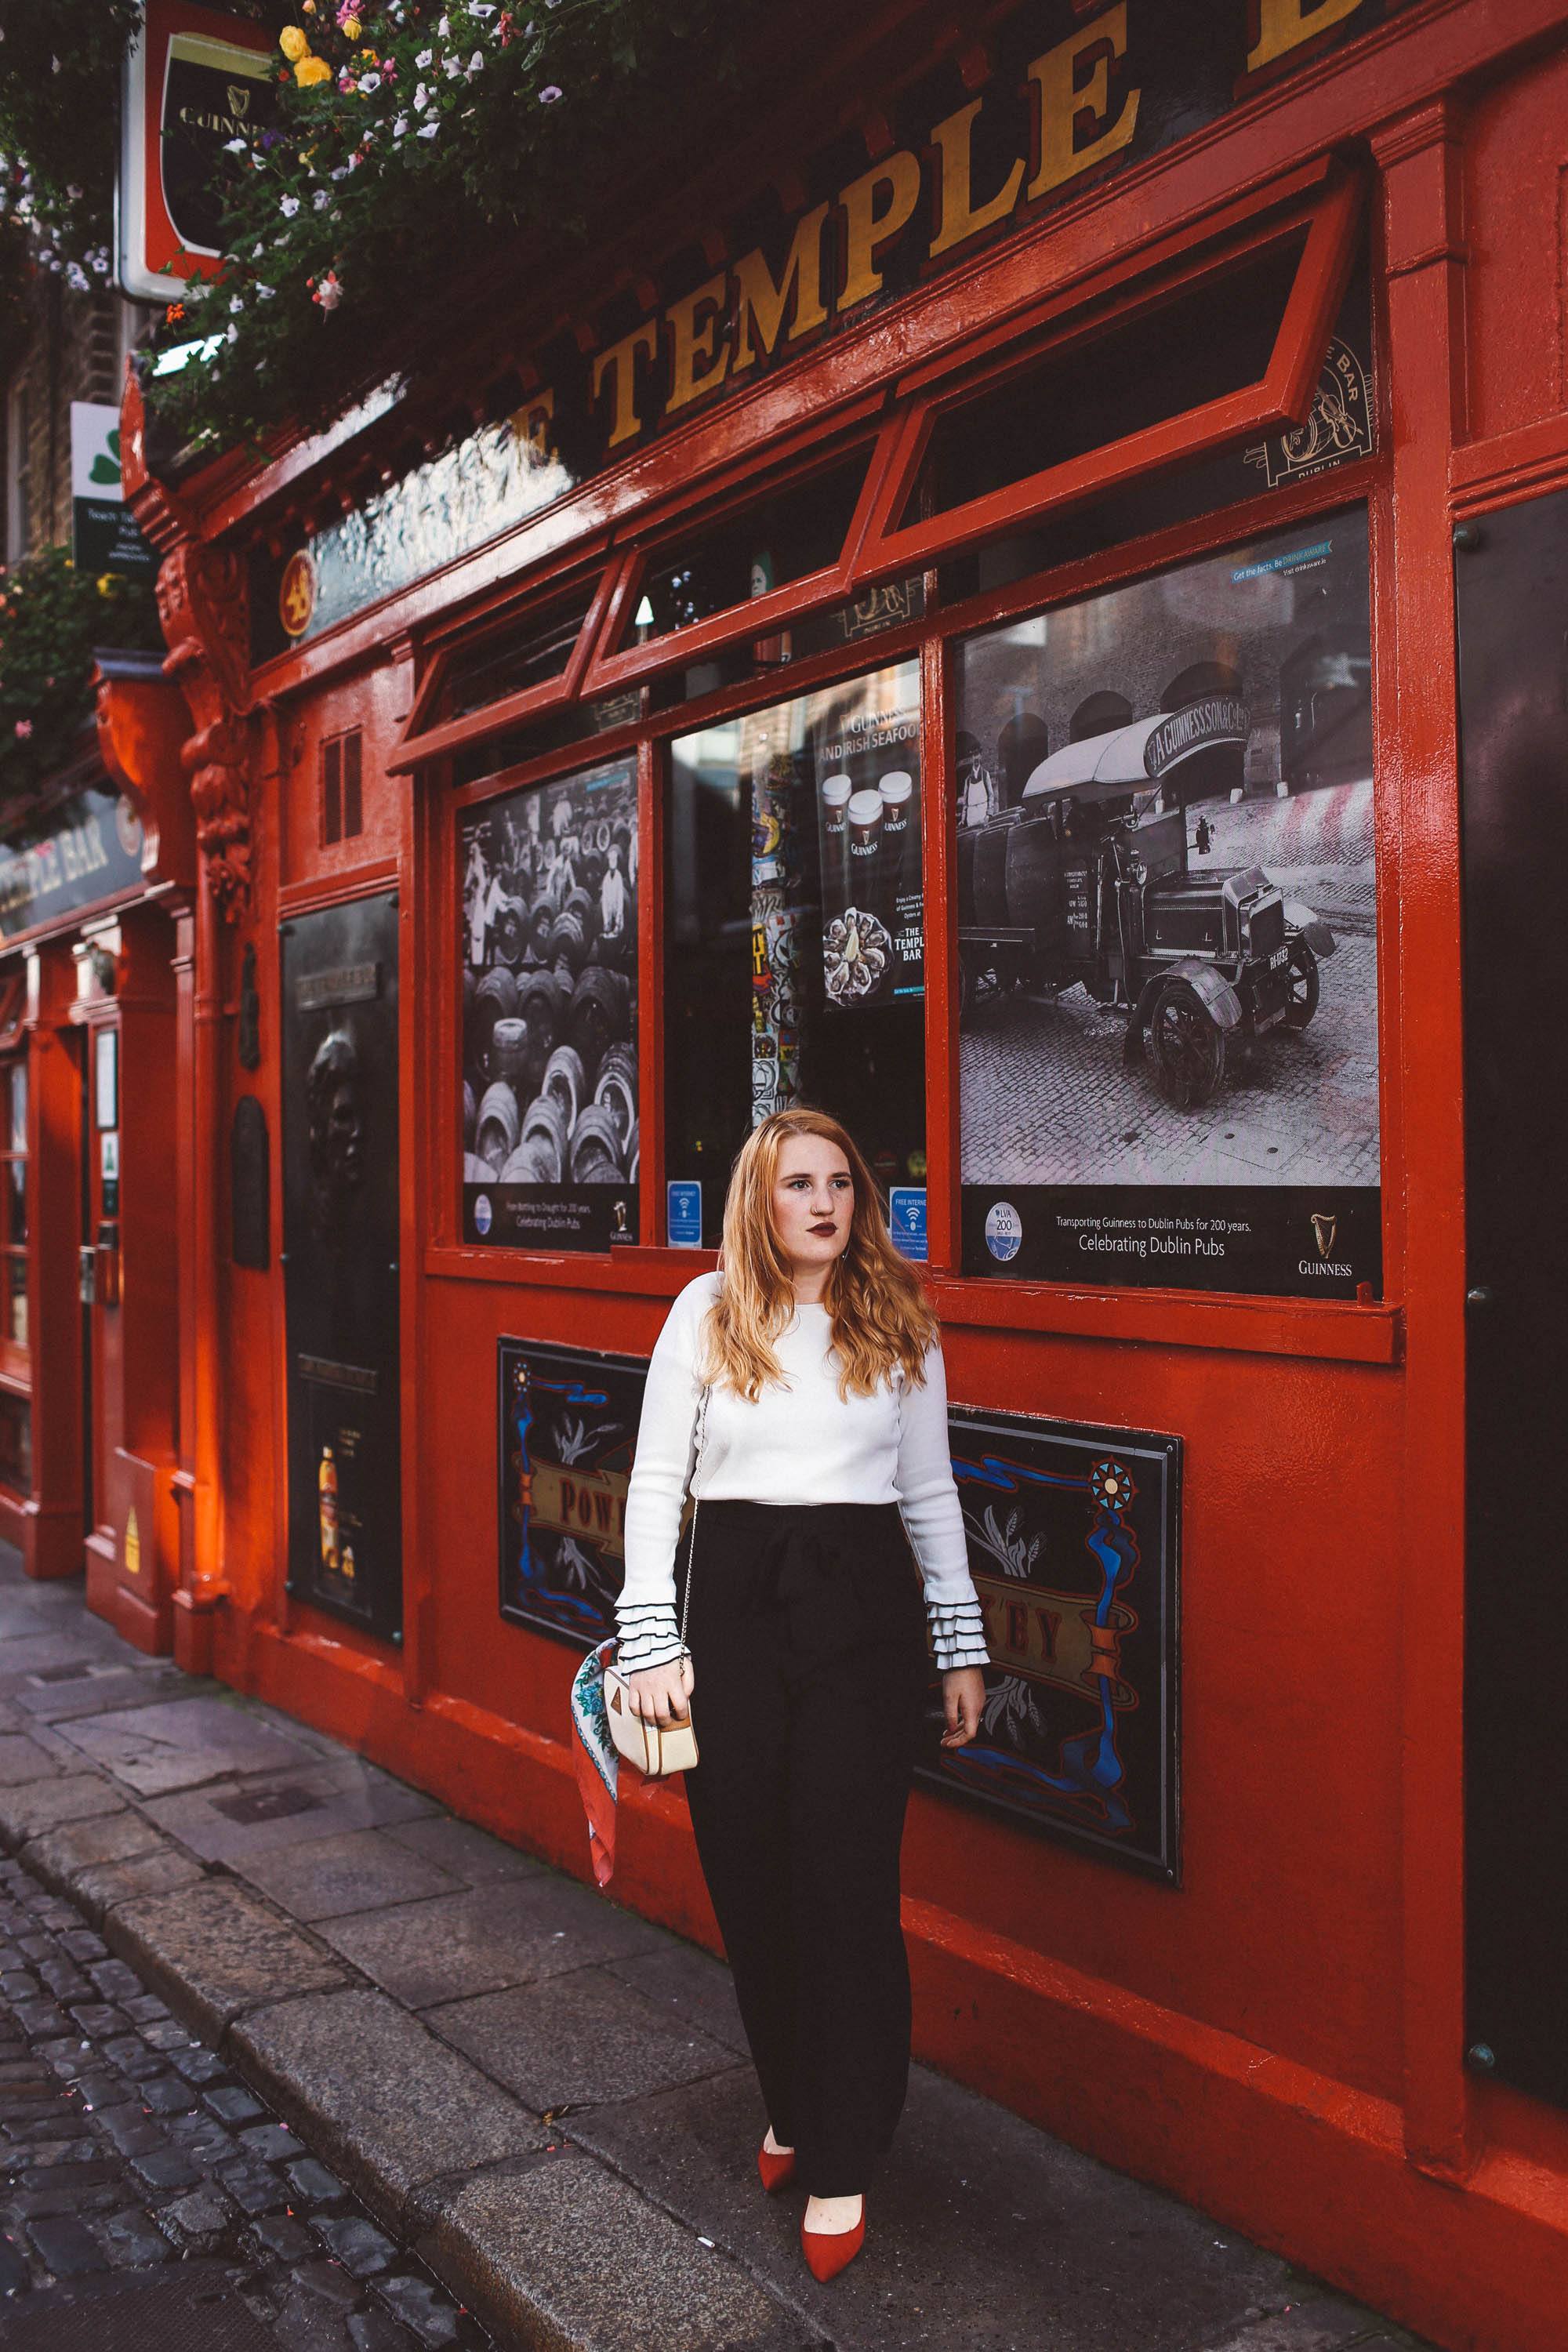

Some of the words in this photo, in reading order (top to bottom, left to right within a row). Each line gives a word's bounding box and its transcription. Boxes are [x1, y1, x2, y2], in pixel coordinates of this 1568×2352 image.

[592, 3, 1142, 448] TEMPLE
[1336, 354, 1359, 402] BAR
[1233, 572, 1244, 581] Get
[1246, 568, 1256, 577] the
[1274, 559, 1283, 568] Be
[820, 745, 842, 761] AND
[843, 737, 870, 755] IRISH
[851, 841, 878, 855] GUINNESS
[905, 927, 920, 938] THE
[894, 936, 924, 951] TEMPL
[902, 949, 922, 961] BAR
[1000, 1210, 1011, 1218] LVA
[517, 1216, 547, 1231] Celebrating
[547, 1217, 565, 1229] Dublin
[996, 1219, 1012, 1231] 200
[1056, 1216, 1101, 1230] Transporting
[1102, 1217, 1136, 1229] Guinness
[1138, 1219, 1147, 1229] to
[1148, 1218, 1174, 1229] Dublin
[1175, 1218, 1195, 1230] Pubs
[1196, 1218, 1208, 1230] for
[1210, 1219, 1226, 1232] 200
[1227, 1221, 1252, 1234] years.
[1079, 1233, 1147, 1257] Celebrating
[1149, 1236, 1192, 1255] Dublin
[1195, 1237, 1225, 1256] Pubs
[1298, 1260, 1352, 1277] GUINNESS
